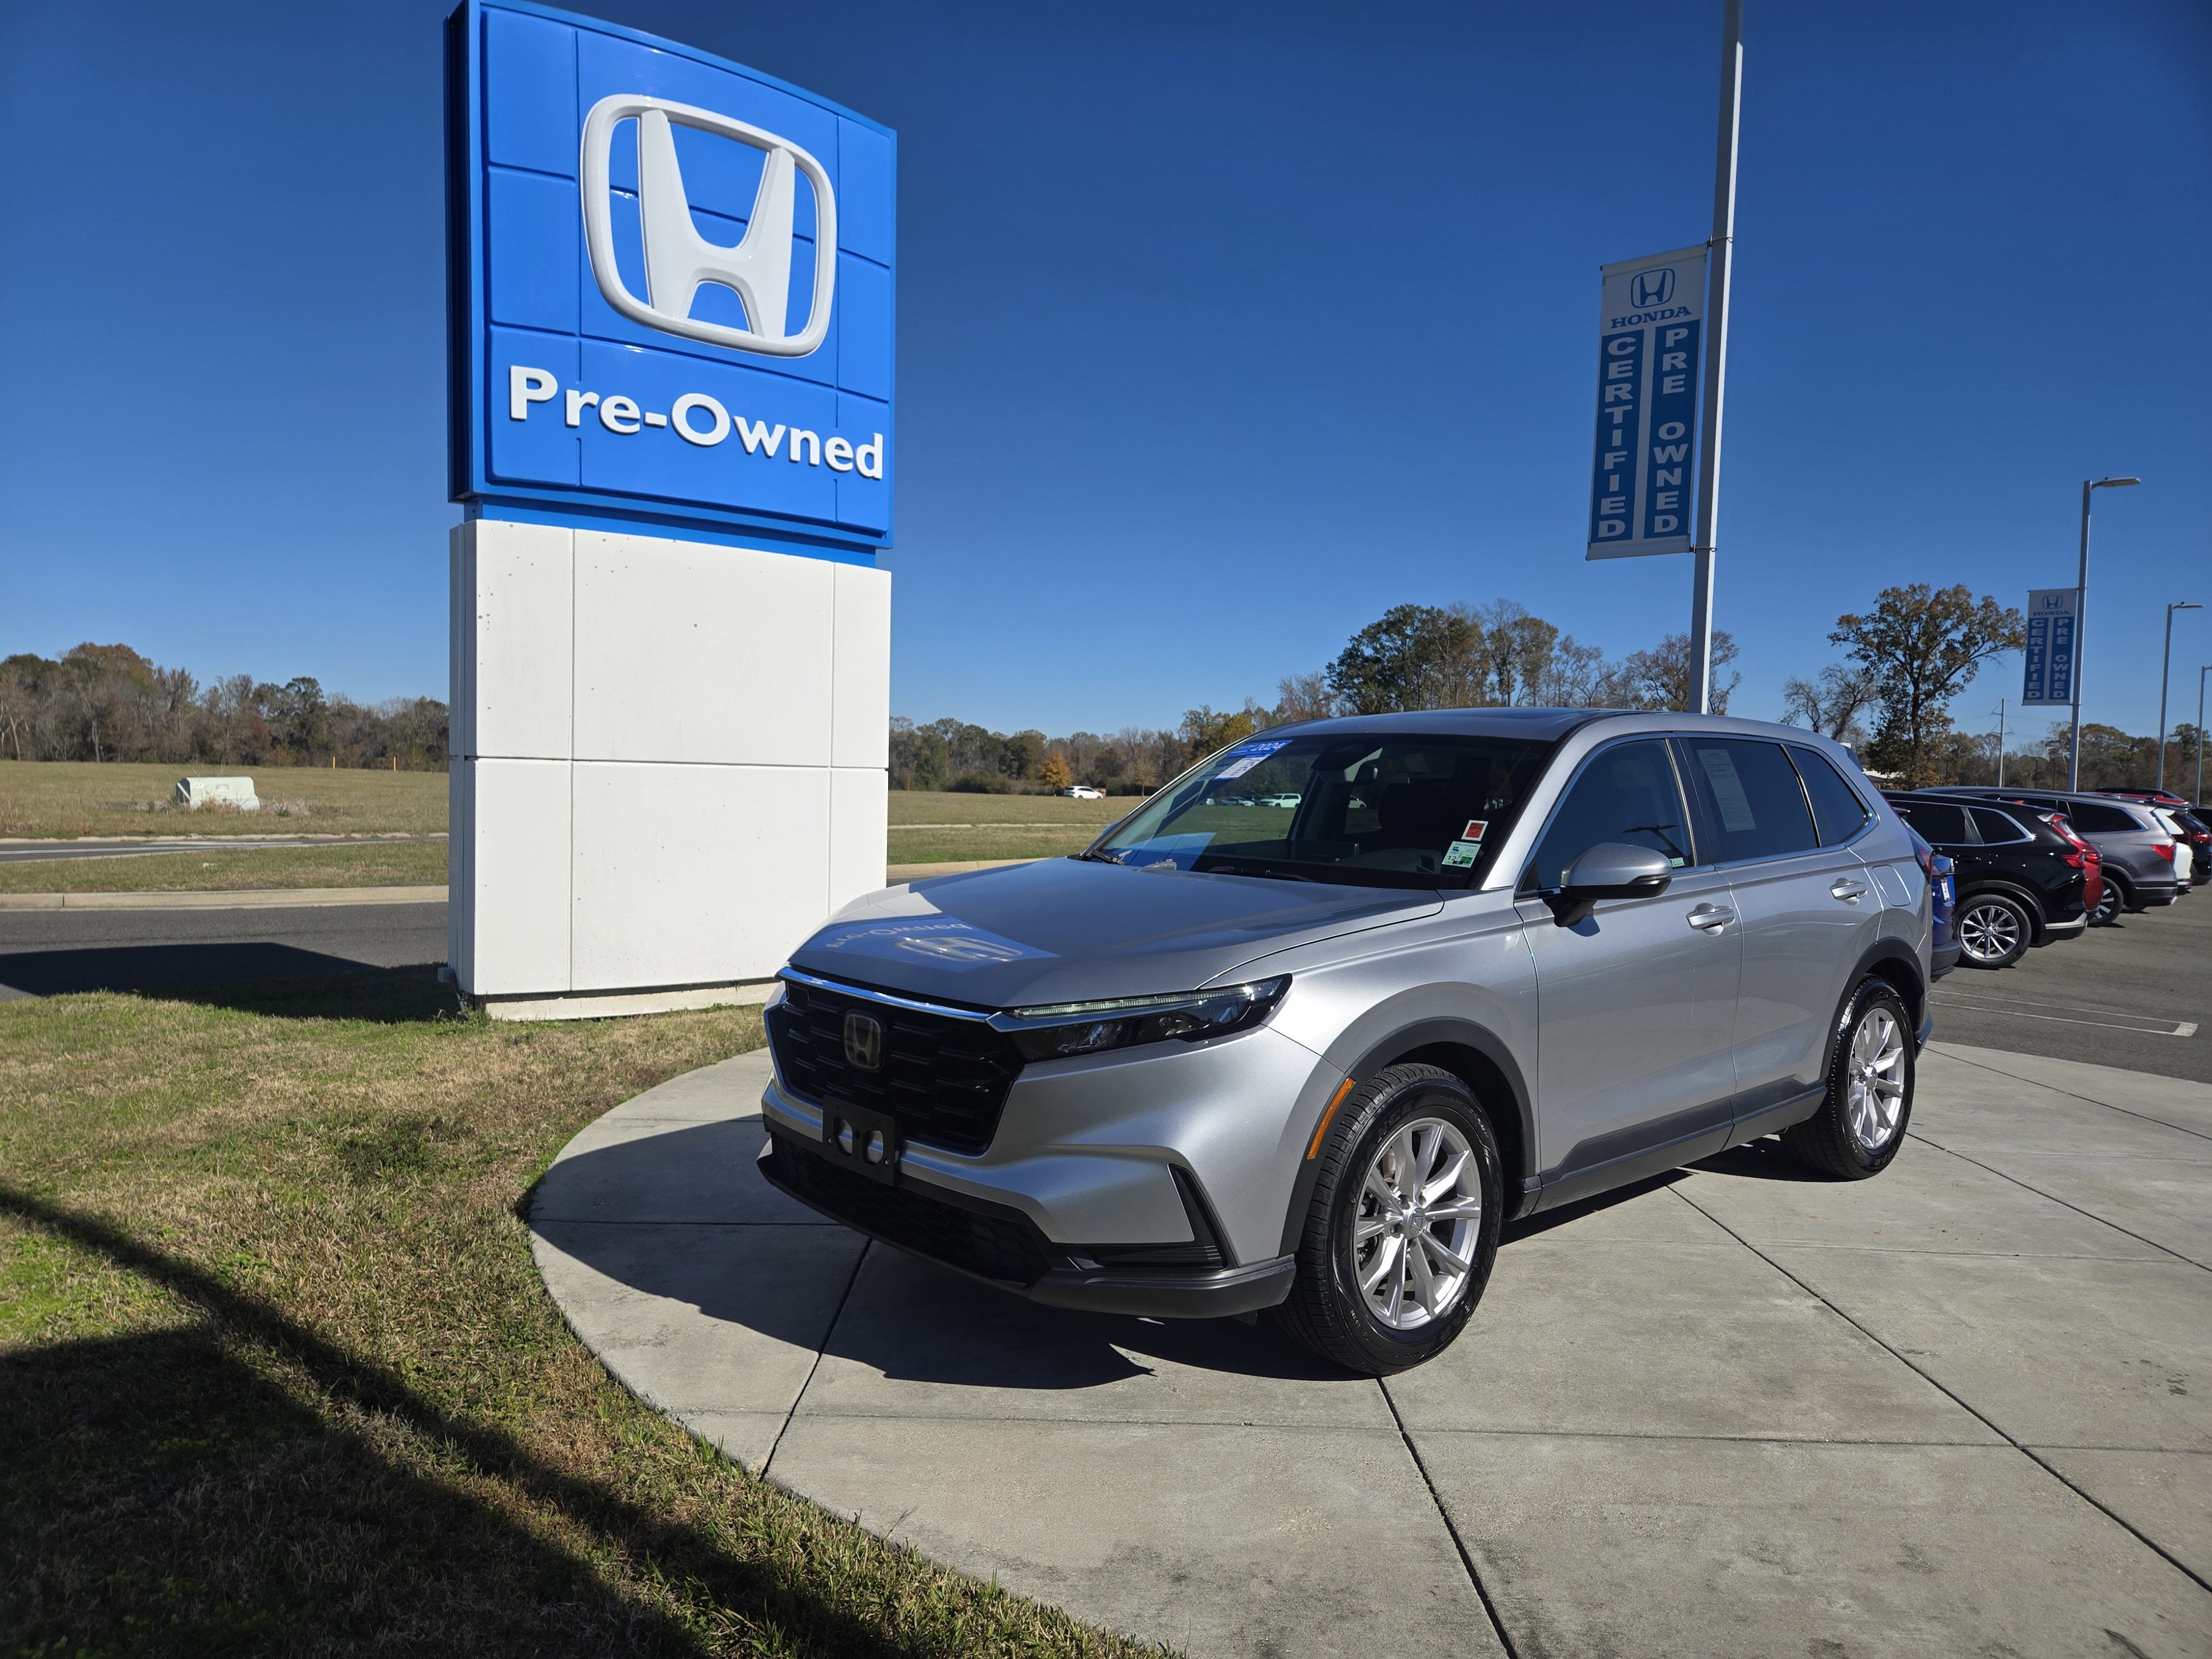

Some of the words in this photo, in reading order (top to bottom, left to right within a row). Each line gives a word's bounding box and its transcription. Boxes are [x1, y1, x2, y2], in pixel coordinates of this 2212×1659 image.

[1610, 306, 1692, 328] HONDA
[1662, 327, 1688, 395] PRE
[509, 365, 884, 481] Pre-Owned
[1598, 336, 1637, 538] CERTIFIED
[1653, 421, 1689, 533] OWNED
[2027, 619, 2045, 698] CERTIFIED
[2056, 618, 2069, 644] PRE
[2053, 654, 2069, 698] OWNED
[1250, 742, 1286, 751] 2024
